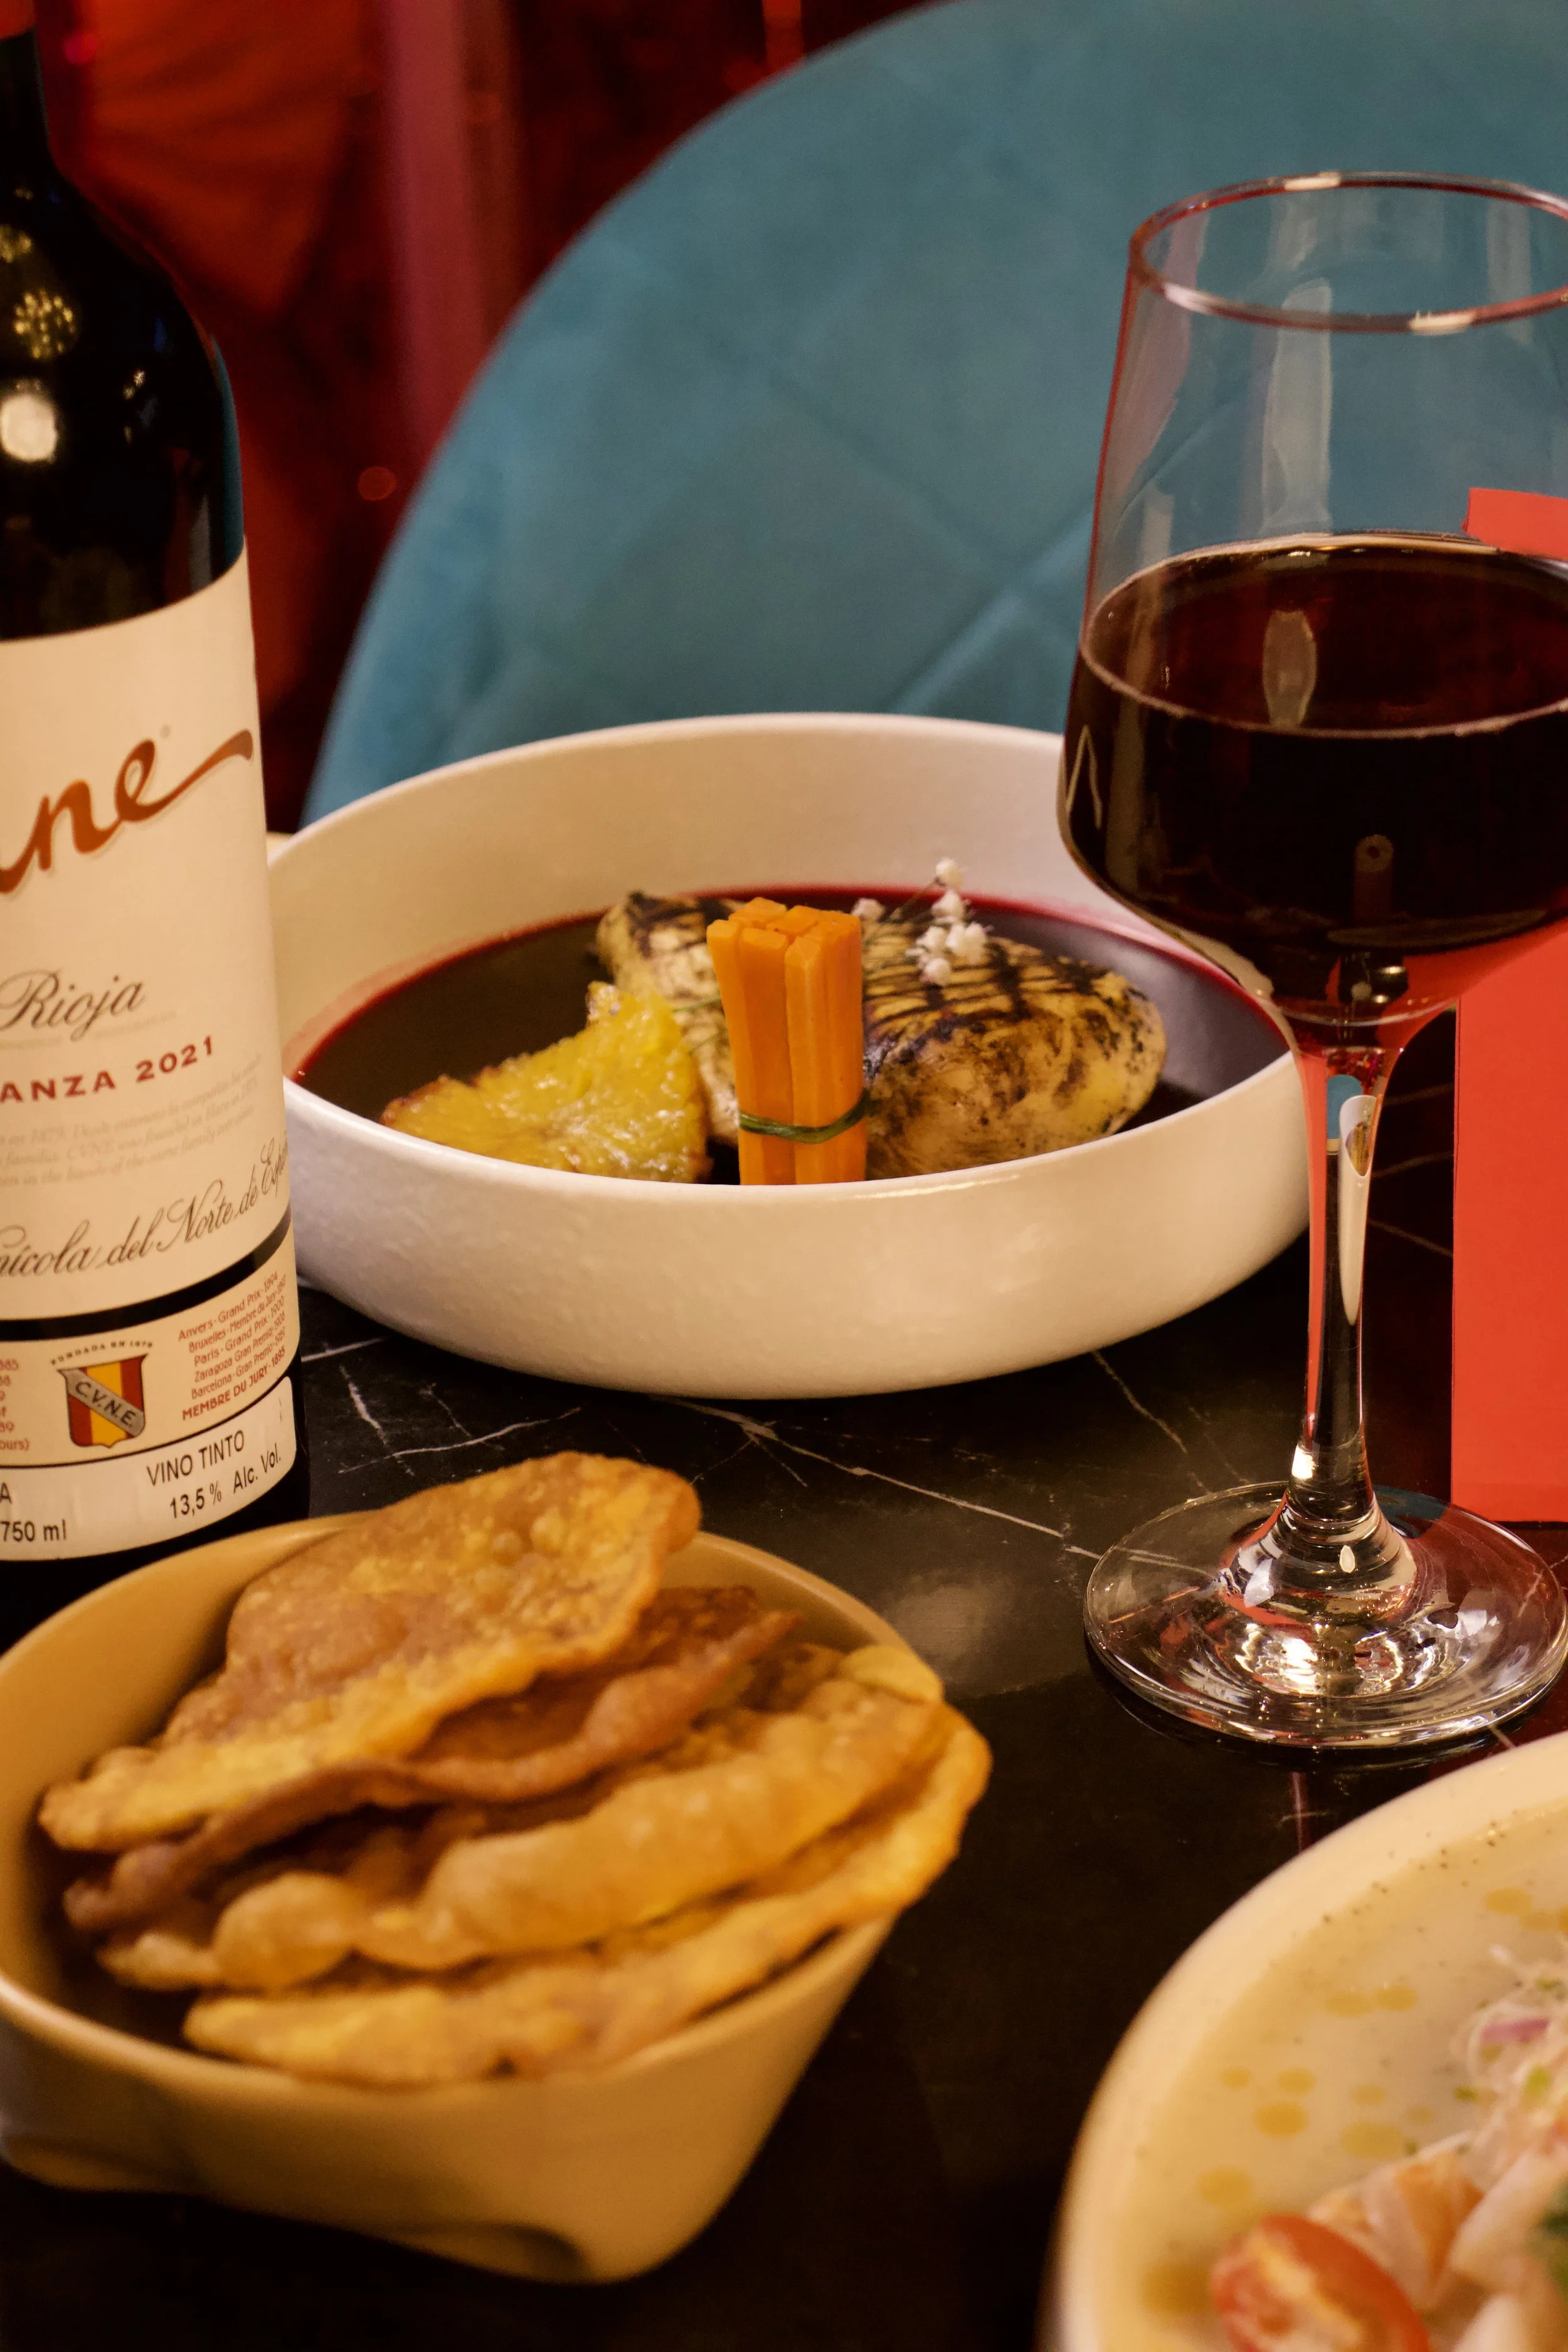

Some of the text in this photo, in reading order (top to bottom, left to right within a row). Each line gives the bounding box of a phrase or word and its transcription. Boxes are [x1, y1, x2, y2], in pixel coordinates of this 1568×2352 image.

[0, 728, 253, 894] ne
[0, 969, 146, 1041] Rioja
[0, 1070, 115, 1104] ANZA
[135, 1035, 213, 1083] 2021
[99, 1207, 164, 1269] del
[157, 1179, 235, 1251] Norte
[235, 1163, 258, 1220] de
[178, 1319, 213, 1342] Anvers
[218, 1299, 245, 1323] Grand
[247, 1289, 260, 1305] Prix
[189, 1329, 226, 1353] Bruxelles
[230, 1309, 257, 1333] Membre
[257, 1301, 265, 1314] du
[194, 1348, 220, 1367] Paris
[225, 1327, 252, 1351] Grand
[254, 1317, 268, 1333] Prix
[191, 1374, 232, 1400] Barcelona
[236, 1360, 252, 1377] Gran
[253, 1343, 273, 1365] Premio
[194, 1357, 233, 1384] Zaragoza
[235, 1345, 251, 1362] Gran
[253, 1327, 272, 1350] Premio
[182, 1390, 231, 1421] MEMBRE
[233, 1380, 246, 1397] DU
[249, 1363, 268, 1387] JURY
[146, 1429, 245, 1486] VINO TINTO
[169, 1443, 282, 1519] 13,5 % Alc. Vol.
[0, 1518, 67, 1542] 750 ml
